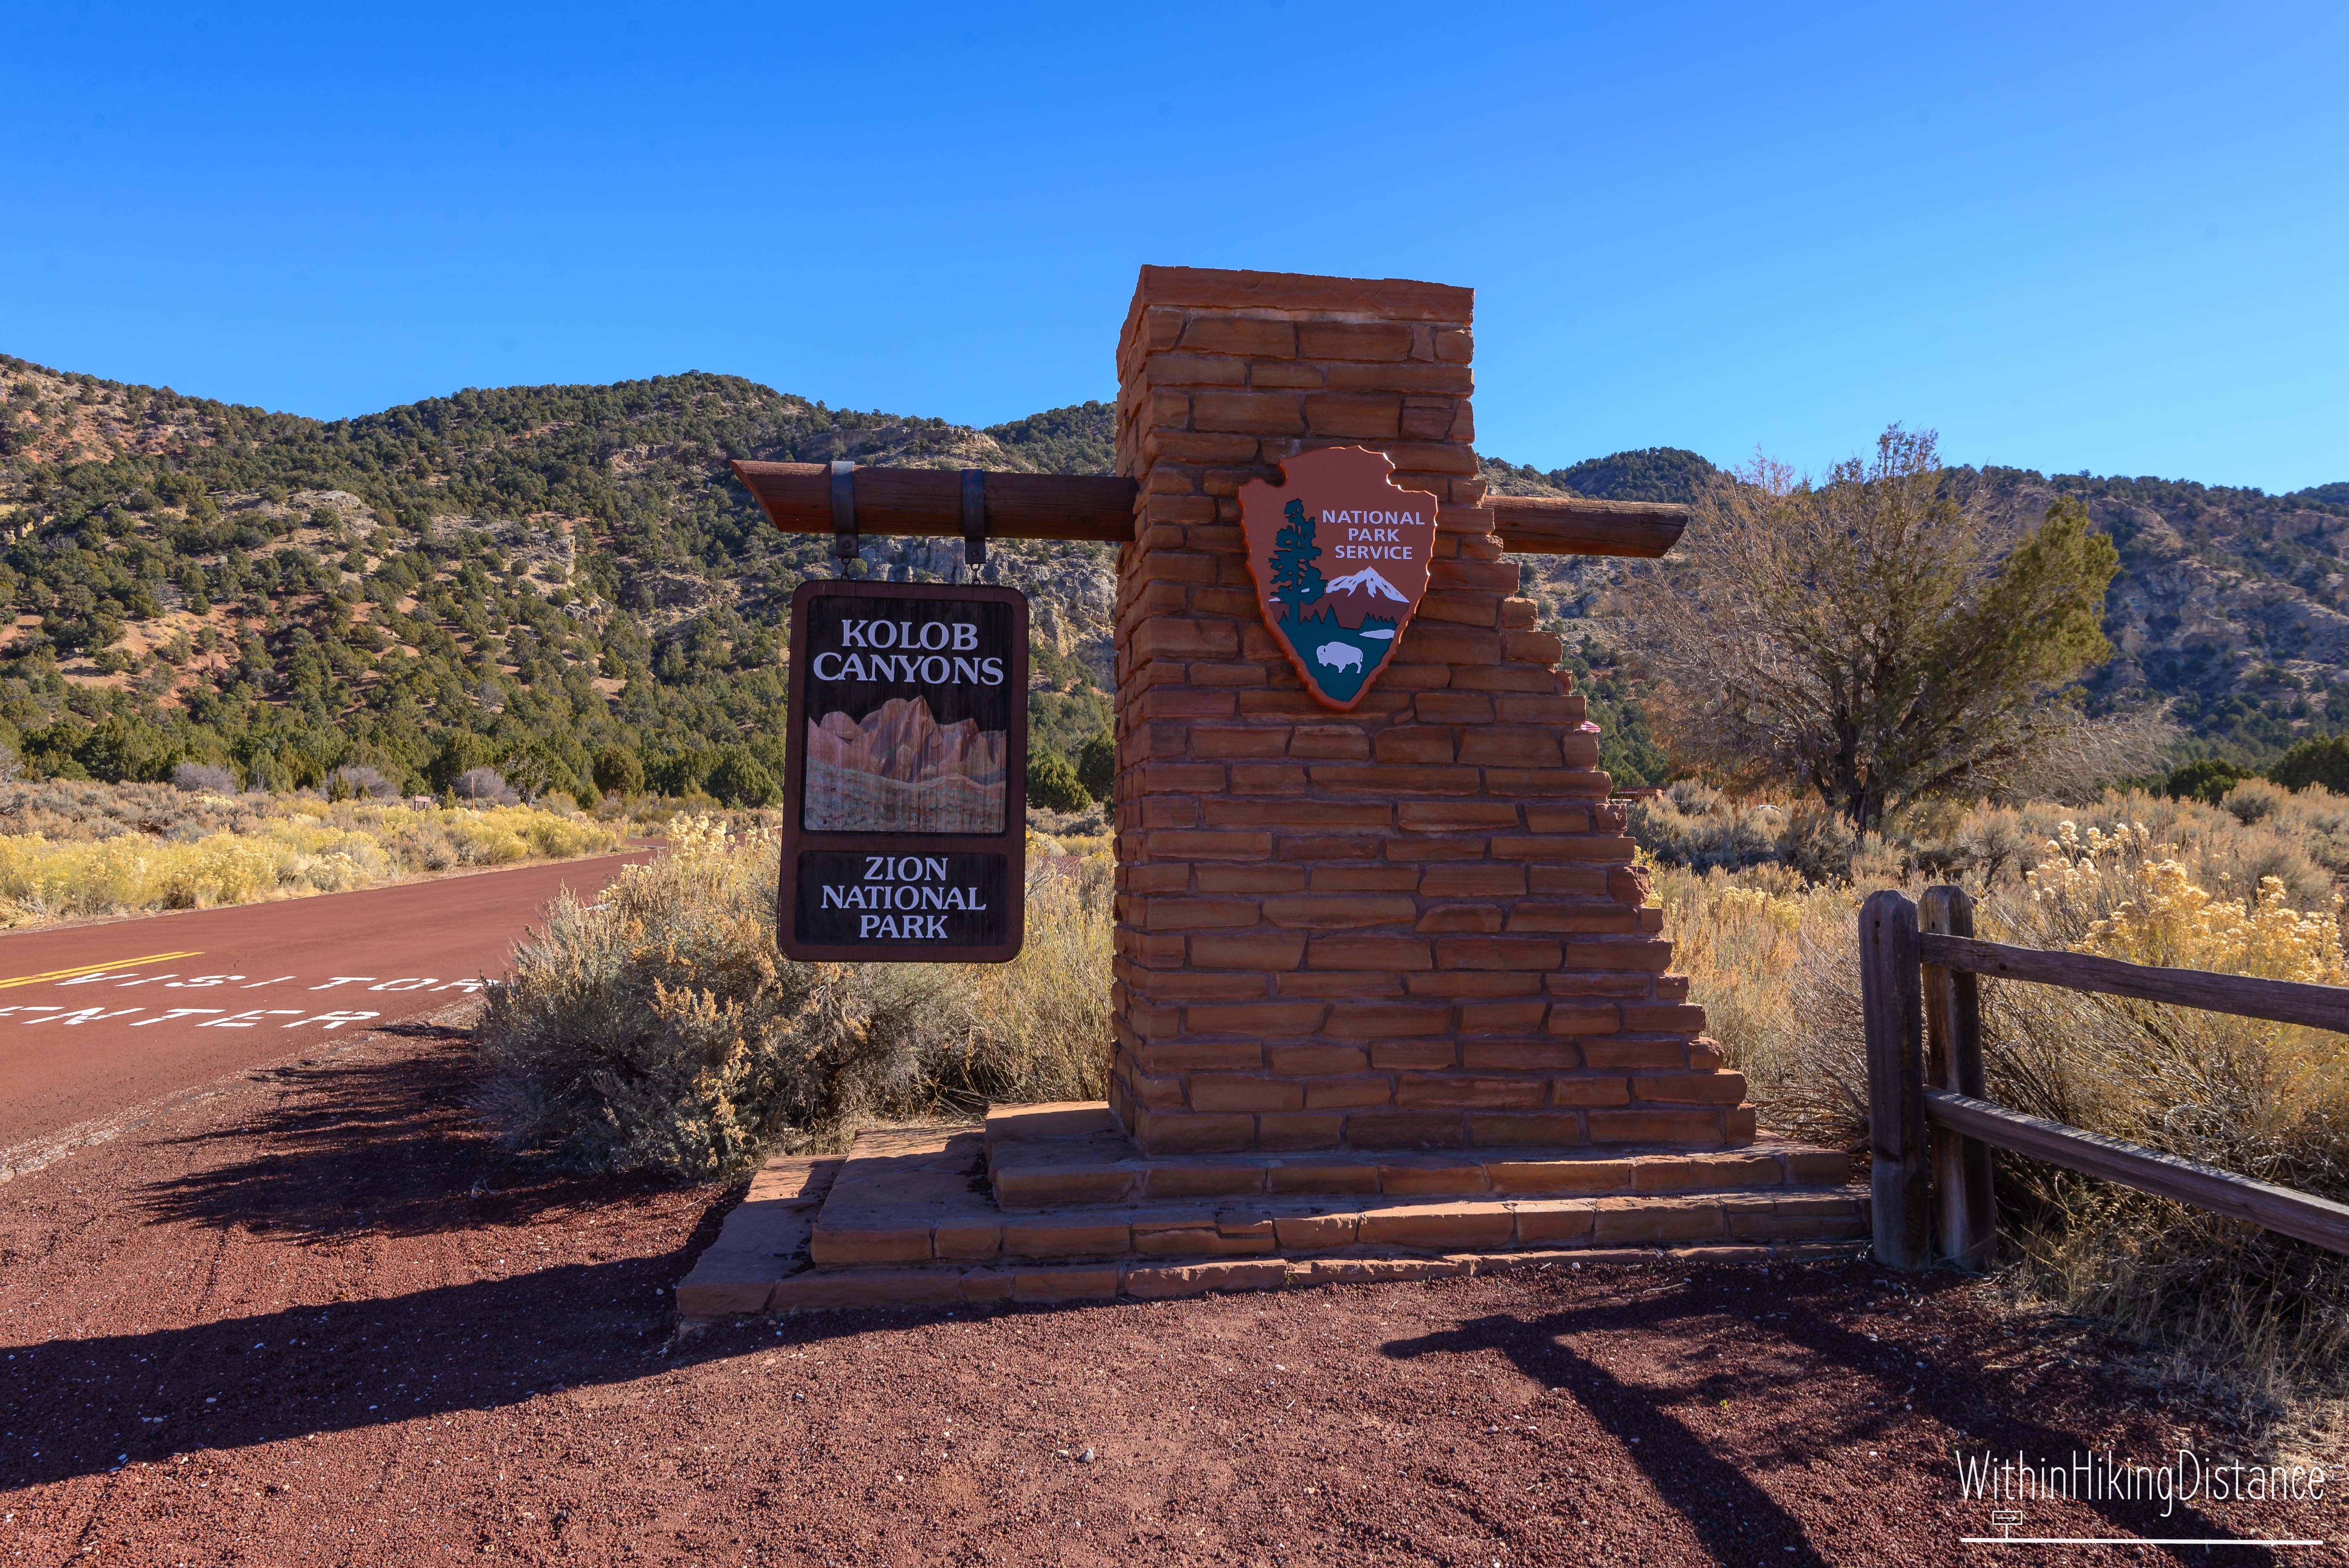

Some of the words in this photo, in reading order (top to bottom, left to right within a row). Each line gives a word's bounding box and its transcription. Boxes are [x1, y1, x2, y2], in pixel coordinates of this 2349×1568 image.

[1322, 509, 1425, 526] NATIONAL
[1348, 528, 1400, 542] PARK
[1335, 545, 1413, 560] SERVICE
[841, 619, 978, 650] KOLOB
[813, 652, 1003, 686] CANYONS
[863, 856, 948, 881] ZION
[821, 885, 986, 911] NATIONAL
[859, 915, 948, 939] PARK
